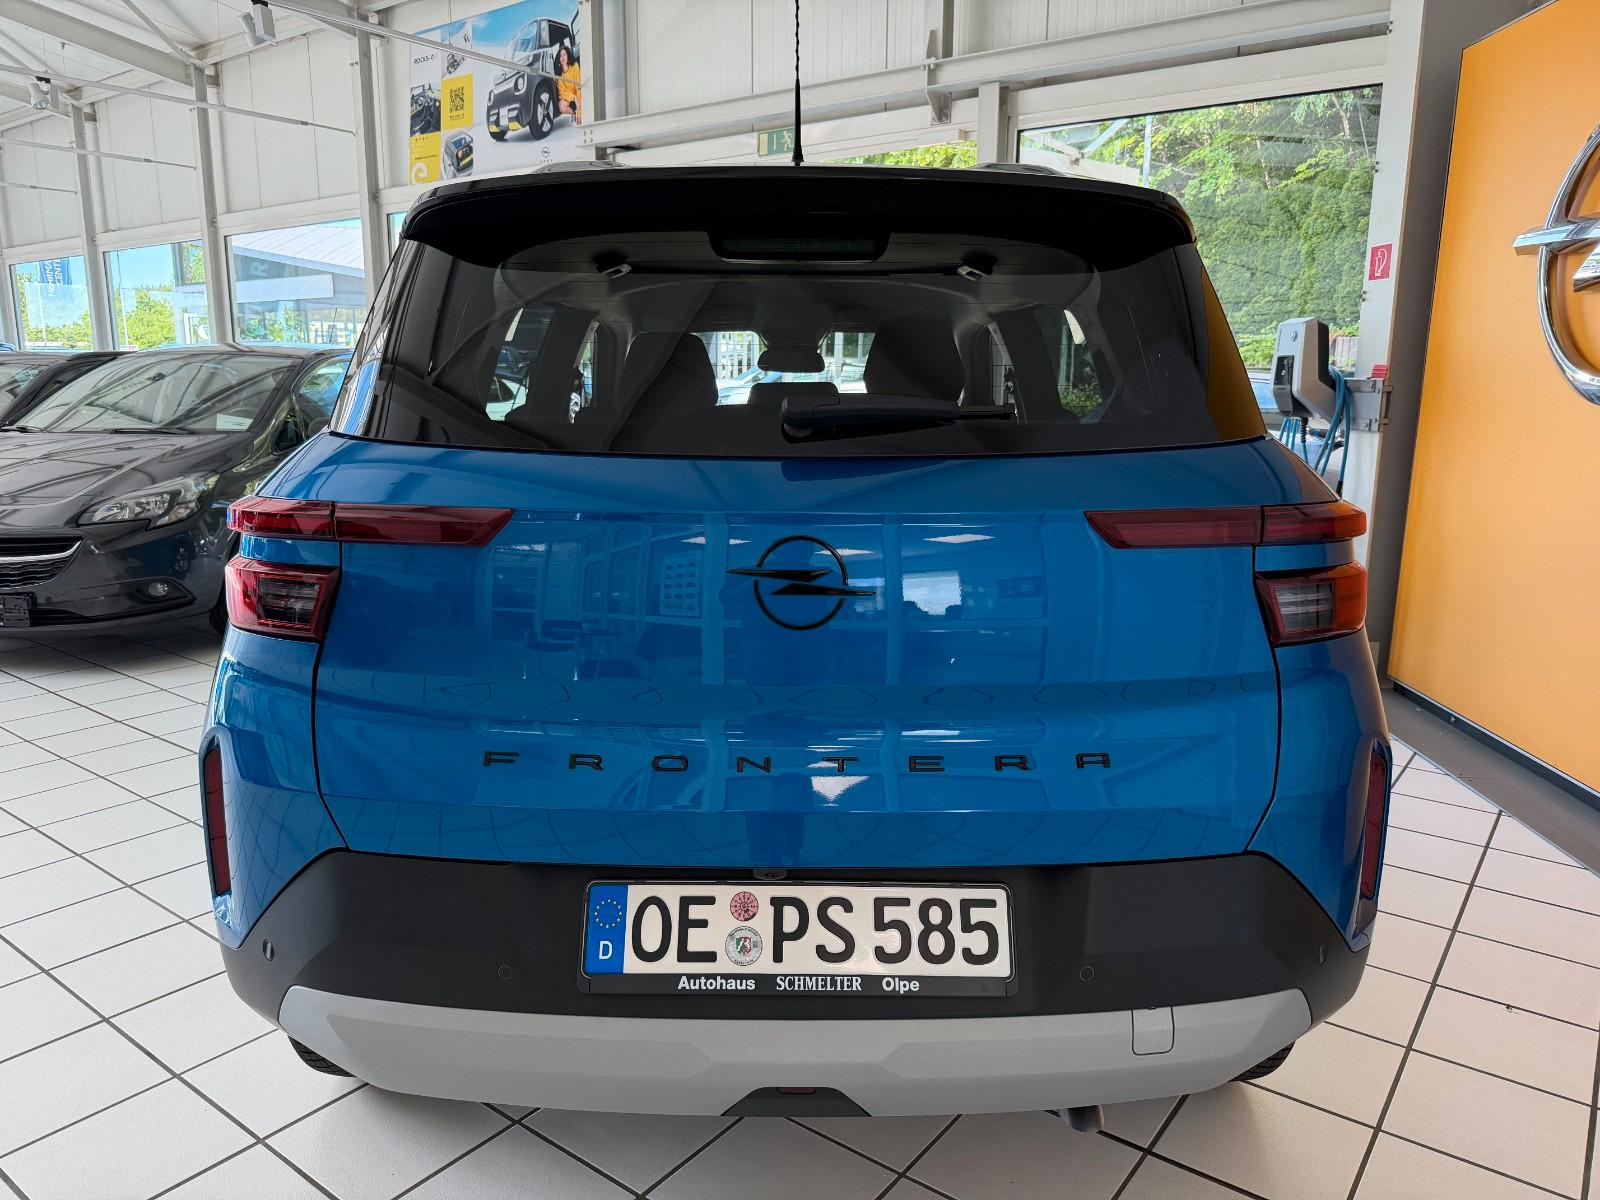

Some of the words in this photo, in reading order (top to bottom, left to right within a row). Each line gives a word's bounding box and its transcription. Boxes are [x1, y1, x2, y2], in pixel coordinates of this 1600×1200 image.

[482, 750, 1111, 773] FRONTERA
[632, 895, 718, 963] OE
[769, 896, 856, 964] PS
[873, 897, 999, 965] 585
[599, 940, 613, 960] D
[677, 975, 756, 990] Autohaus
[776, 976, 862, 991] SCHMELTER
[881, 976, 920, 994] Olpe
